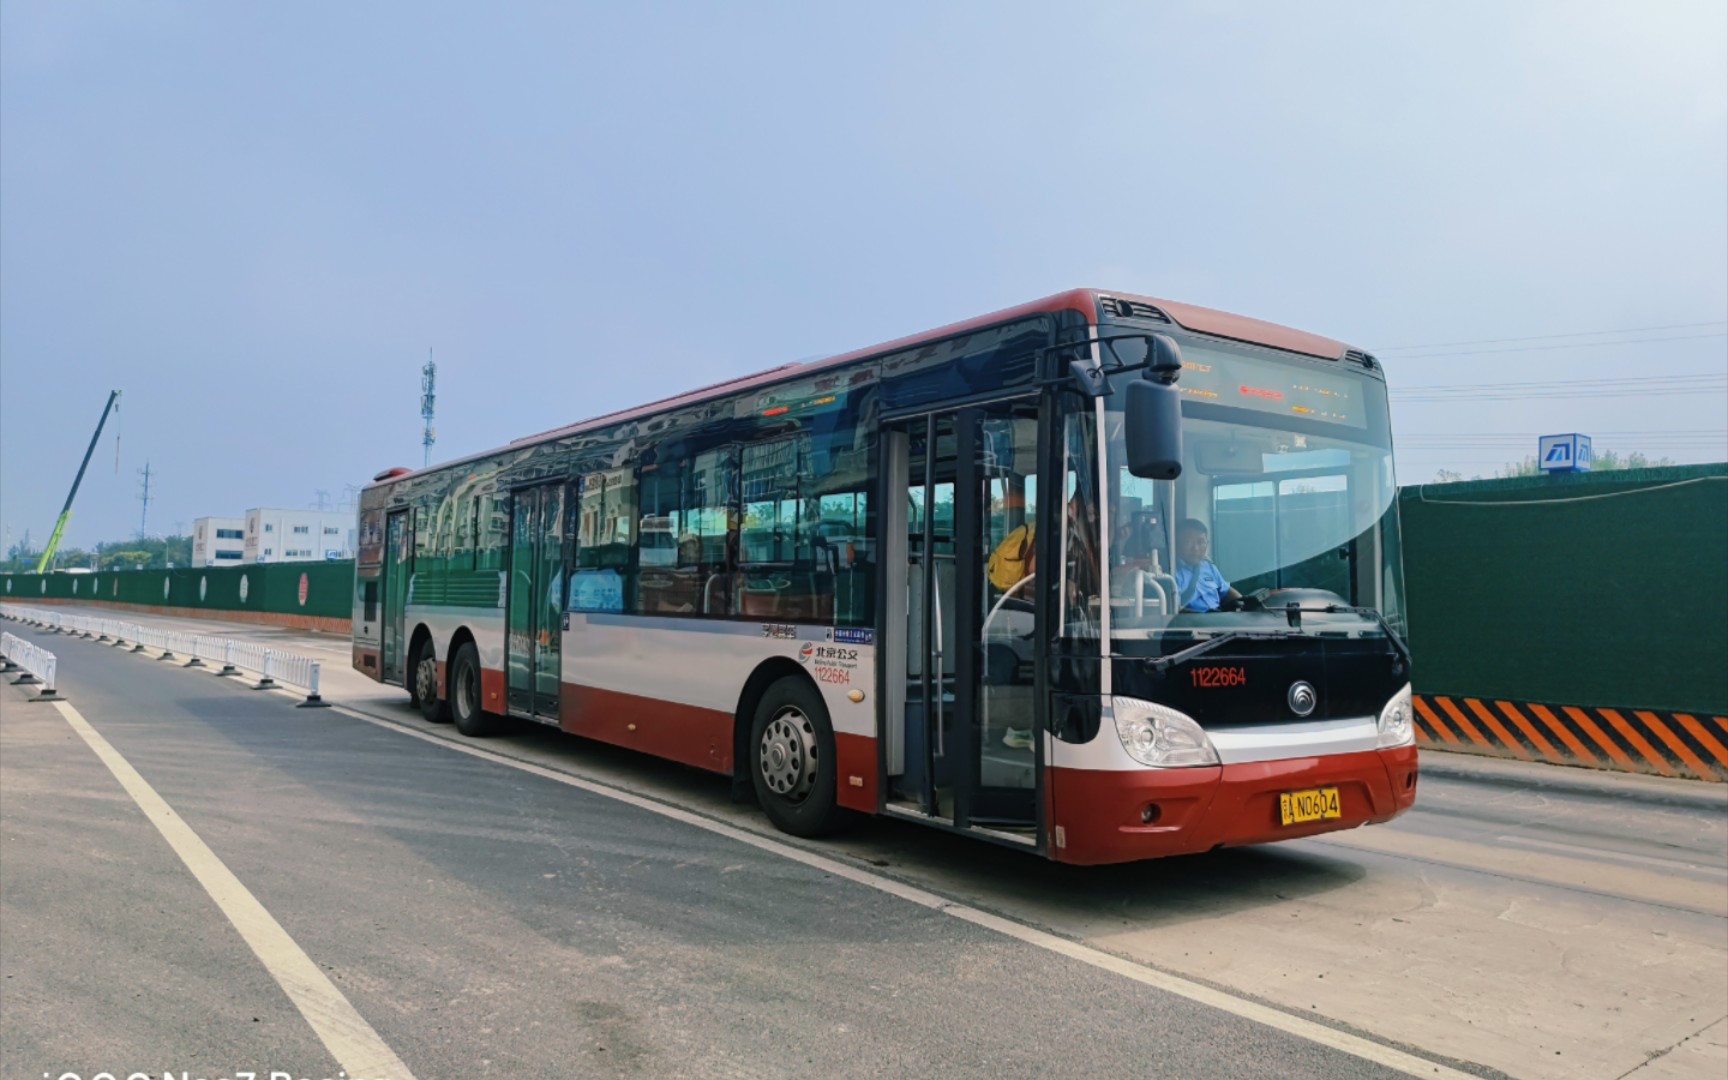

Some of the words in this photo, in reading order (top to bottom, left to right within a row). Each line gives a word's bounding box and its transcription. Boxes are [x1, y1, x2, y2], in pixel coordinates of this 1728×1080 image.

[816, 646, 858, 660] 北京公交
[815, 667, 850, 684] 1122664
[1190, 667, 1246, 687] 1122664
